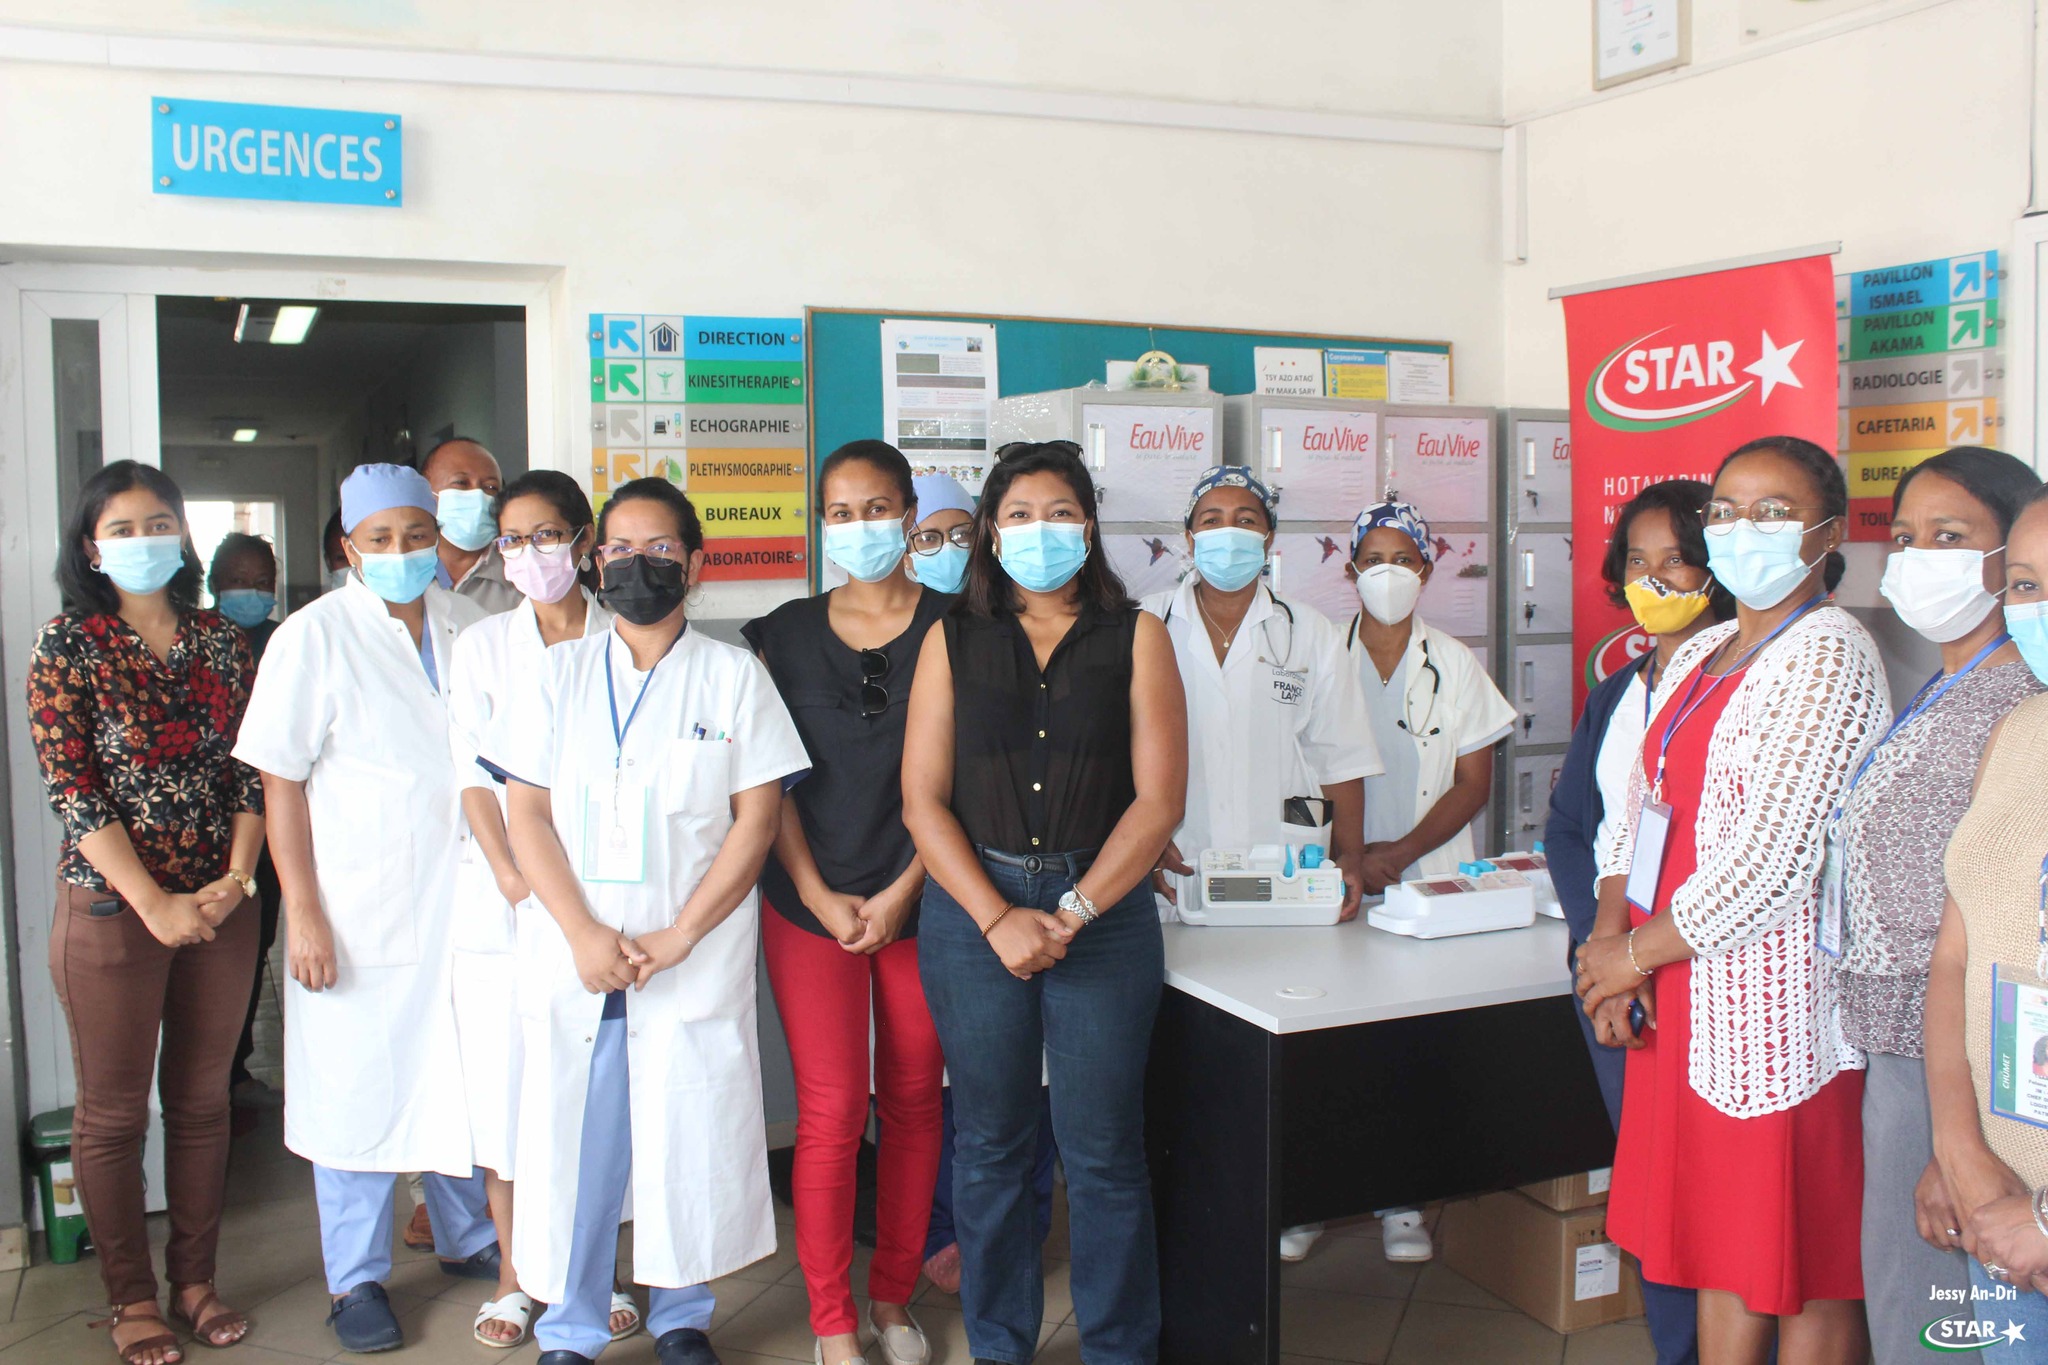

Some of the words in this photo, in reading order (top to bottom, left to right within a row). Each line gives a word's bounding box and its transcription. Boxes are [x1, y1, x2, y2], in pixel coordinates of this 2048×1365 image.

[172, 123, 383, 182] URGENCES
[1862, 264, 1933, 288] PAVILLON
[1869, 290, 1923, 310] ISMAEL
[1863, 311, 1934, 333] PAVILLON
[699, 331, 785, 346] DIRECTION
[1869, 335, 1924, 354] AKAMA
[1624, 340, 1736, 394] STAR
[688, 375, 790, 389] KINESITHERAPIE
[1265, 374, 1277, 382] TSY
[1279, 374, 1293, 382] AZO
[1853, 369, 1943, 390] RADIOLOGIE
[1265, 387, 1275, 395] NY
[1276, 387, 1297, 395] MAKA
[1298, 388, 1316, 396] SARY
[690, 419, 790, 433] ECHOGRAPHIE
[1857, 416, 1936, 435] CAFETARIA
[690, 462, 792, 477] PLETHYSMOGRAPHIE
[1861, 466, 1913, 481] BUREA
[706, 507, 782, 521] BUREAUX
[702, 550, 794, 566] ABORATOIRE
[1273, 680, 1303, 697] FRANCE
